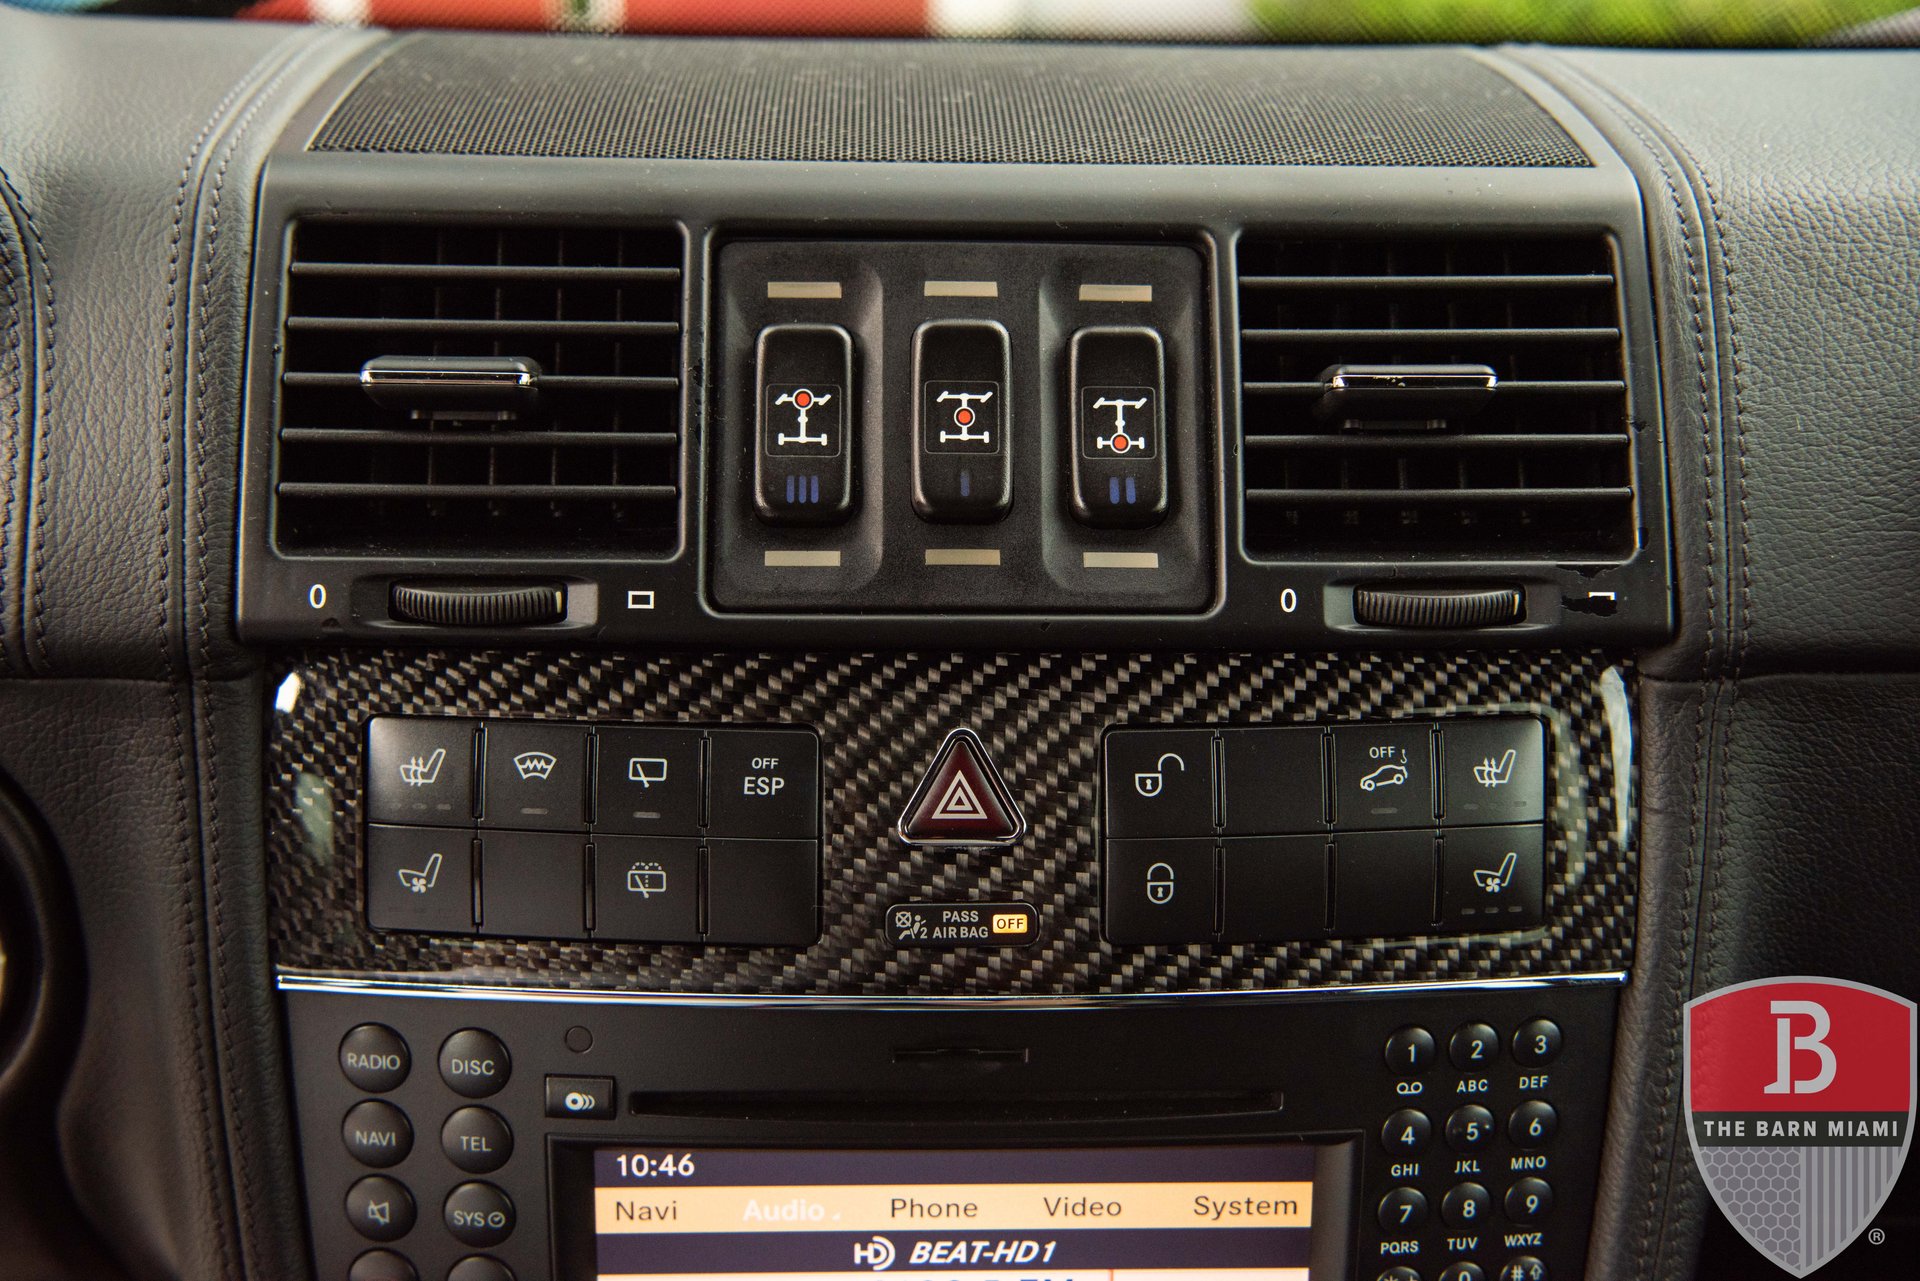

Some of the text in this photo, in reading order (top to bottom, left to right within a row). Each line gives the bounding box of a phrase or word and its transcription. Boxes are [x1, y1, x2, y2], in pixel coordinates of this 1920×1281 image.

[1370, 747, 1395, 758] OFF
[752, 758, 778, 769] OFF
[744, 777, 784, 795] ESP
[943, 911, 978, 922] PASS
[997, 919, 1023, 929] OFF
[1472, 1040, 1482, 1058] 2
[1535, 1035, 1546, 1053] 3
[346, 1052, 400, 1069] RADIO
[1408, 1045, 1414, 1061] 1
[452, 1059, 495, 1075] DISC
[1457, 1079, 1487, 1092] ABC
[1520, 1076, 1548, 1088] DEF
[1467, 1123, 1478, 1140] 5
[1530, 1118, 1541, 1135] 6
[355, 1130, 395, 1145] NAVI
[1401, 1126, 1414, 1144] 4
[460, 1136, 492, 1152] TEL
[617, 1154, 694, 1176] 10:46
[1391, 1164, 1418, 1176] GHI
[1455, 1161, 1480, 1173] JKL
[1511, 1156, 1546, 1169] MNO
[617, 1196, 1297, 1221] Navi Audio Phone Video System
[1463, 1200, 1475, 1217] 8
[1527, 1195, 1538, 1212] 9
[454, 1211, 484, 1227] SYS
[1400, 1205, 1412, 1222] 7
[1381, 1241, 1418, 1254] PQRS
[1448, 1237, 1477, 1250] TUV
[1505, 1233, 1541, 1246] WXYZ
[910, 1241, 1056, 1263] BEAT-HD1
